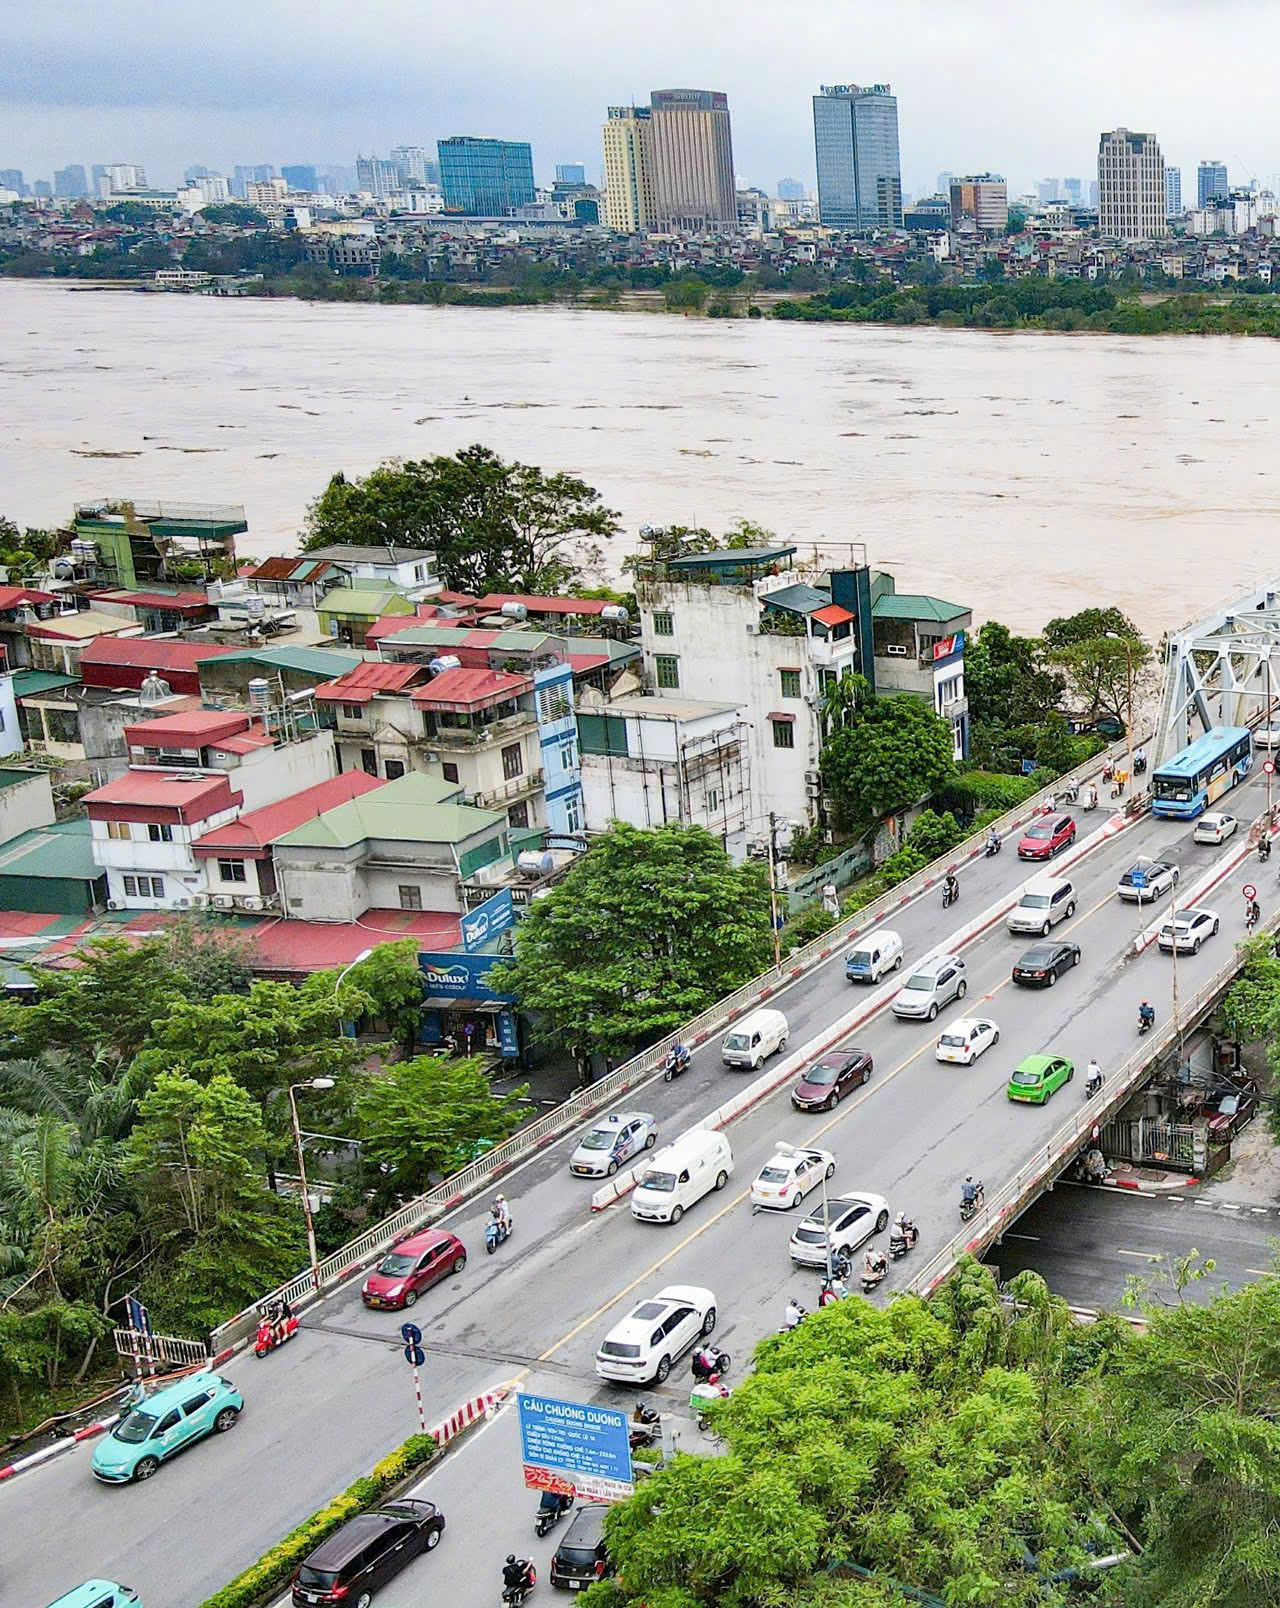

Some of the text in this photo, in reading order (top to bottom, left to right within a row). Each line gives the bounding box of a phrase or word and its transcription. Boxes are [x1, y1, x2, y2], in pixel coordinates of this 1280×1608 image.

[427, 972, 466, 984] Dulux
[545, 1404, 585, 1420] CHƯƠNG
[587, 1412, 622, 1427] DƯƠNG
